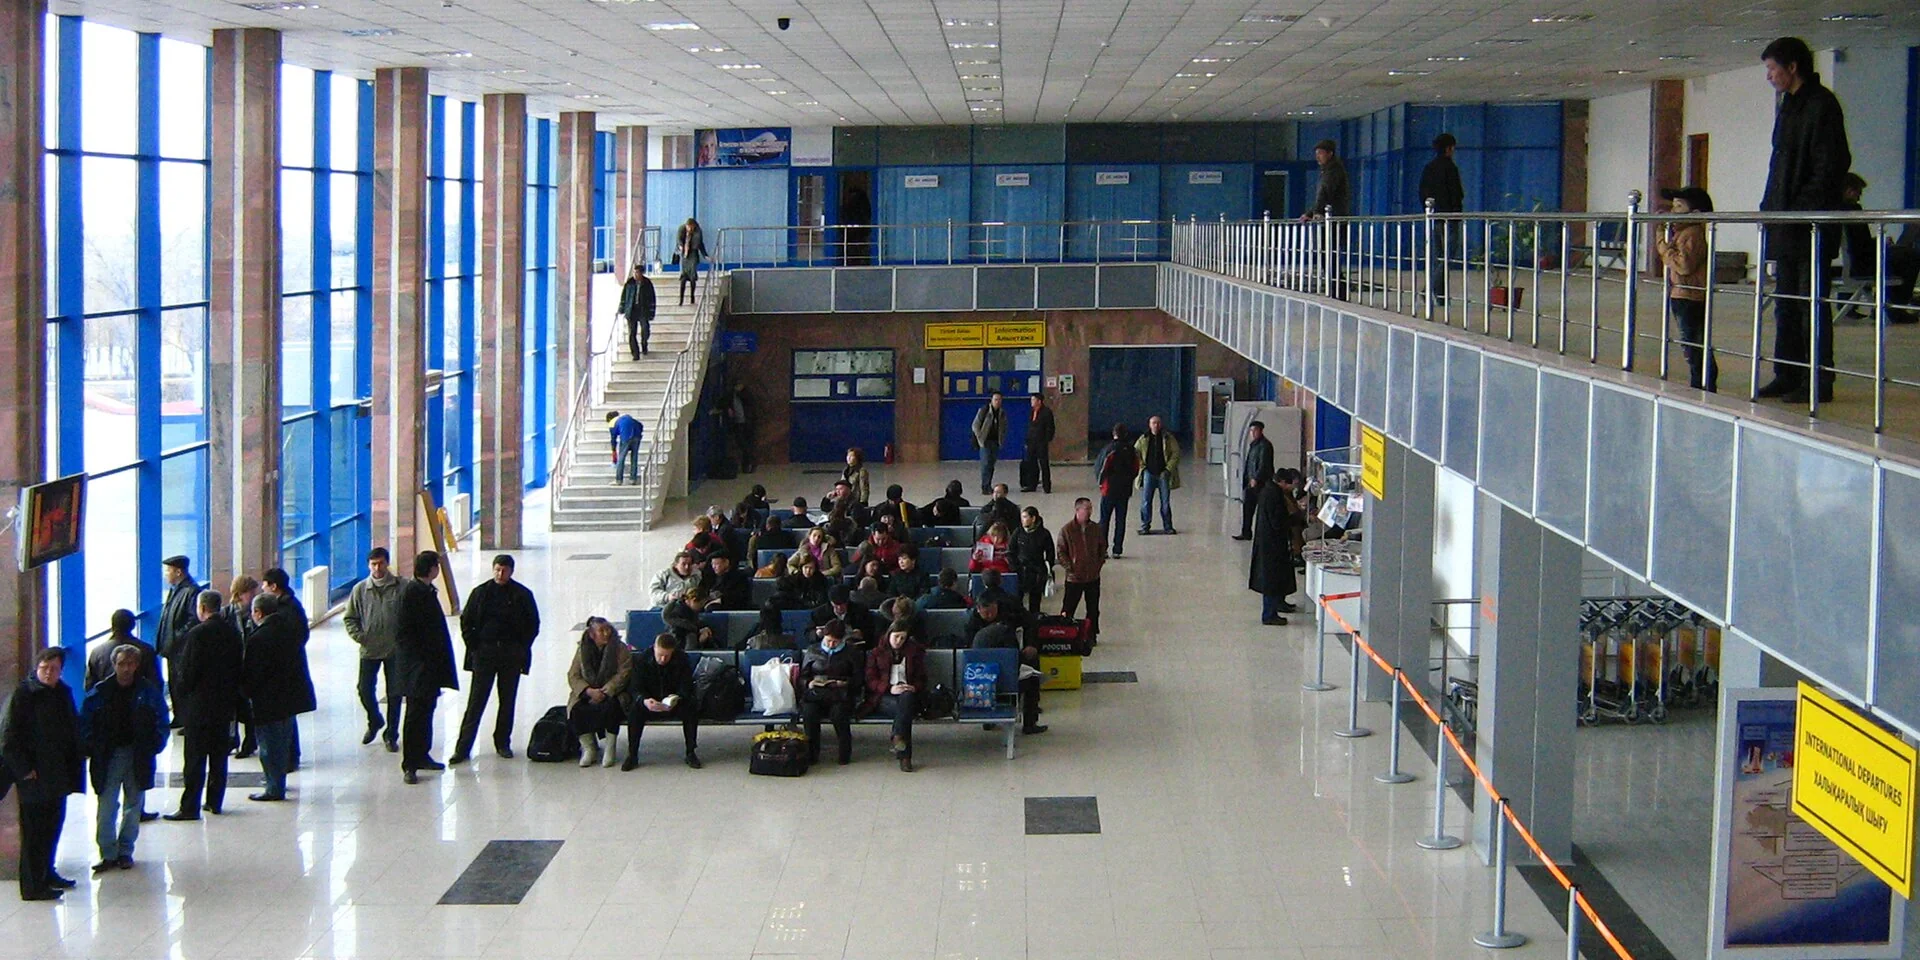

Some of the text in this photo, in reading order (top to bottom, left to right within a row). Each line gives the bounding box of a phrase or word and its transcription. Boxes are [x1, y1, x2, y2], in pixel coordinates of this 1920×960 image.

[1805, 731, 1902, 807] INTERNATIONAL DEPARTURES
[1814, 770, 1865, 822] ХАЛЫҚАРАЛЫҚ
